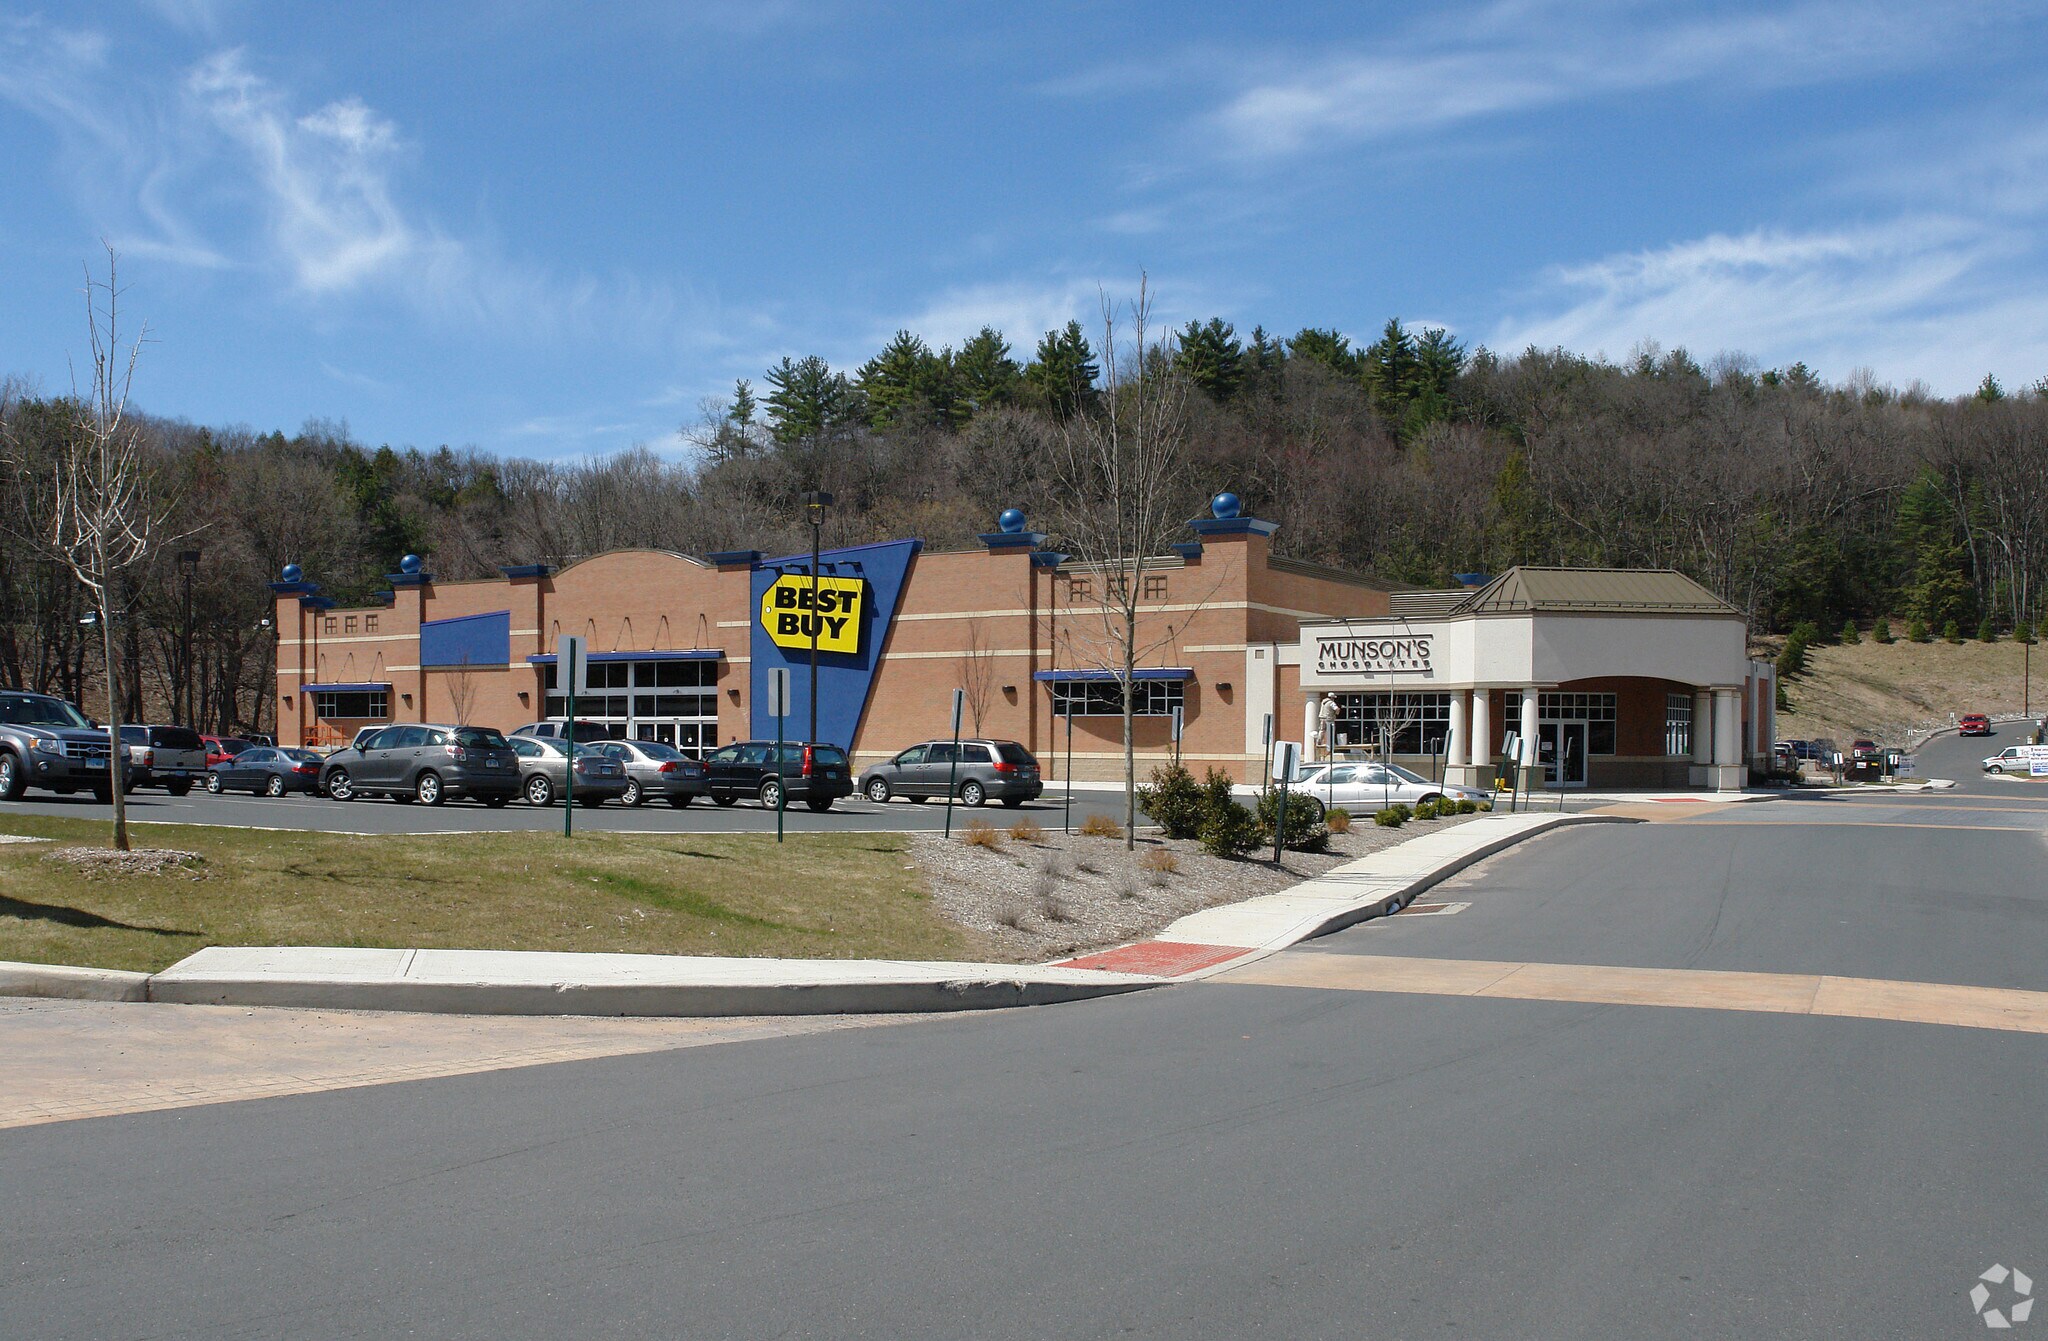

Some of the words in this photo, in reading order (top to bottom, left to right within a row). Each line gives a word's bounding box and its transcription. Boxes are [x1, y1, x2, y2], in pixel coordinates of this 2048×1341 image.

[775, 587, 857, 613] BEST
[778, 613, 849, 639] BUY
[1319, 640, 1430, 660] MUNSON'S
[1318, 660, 1431, 669] CHOCOLATES
